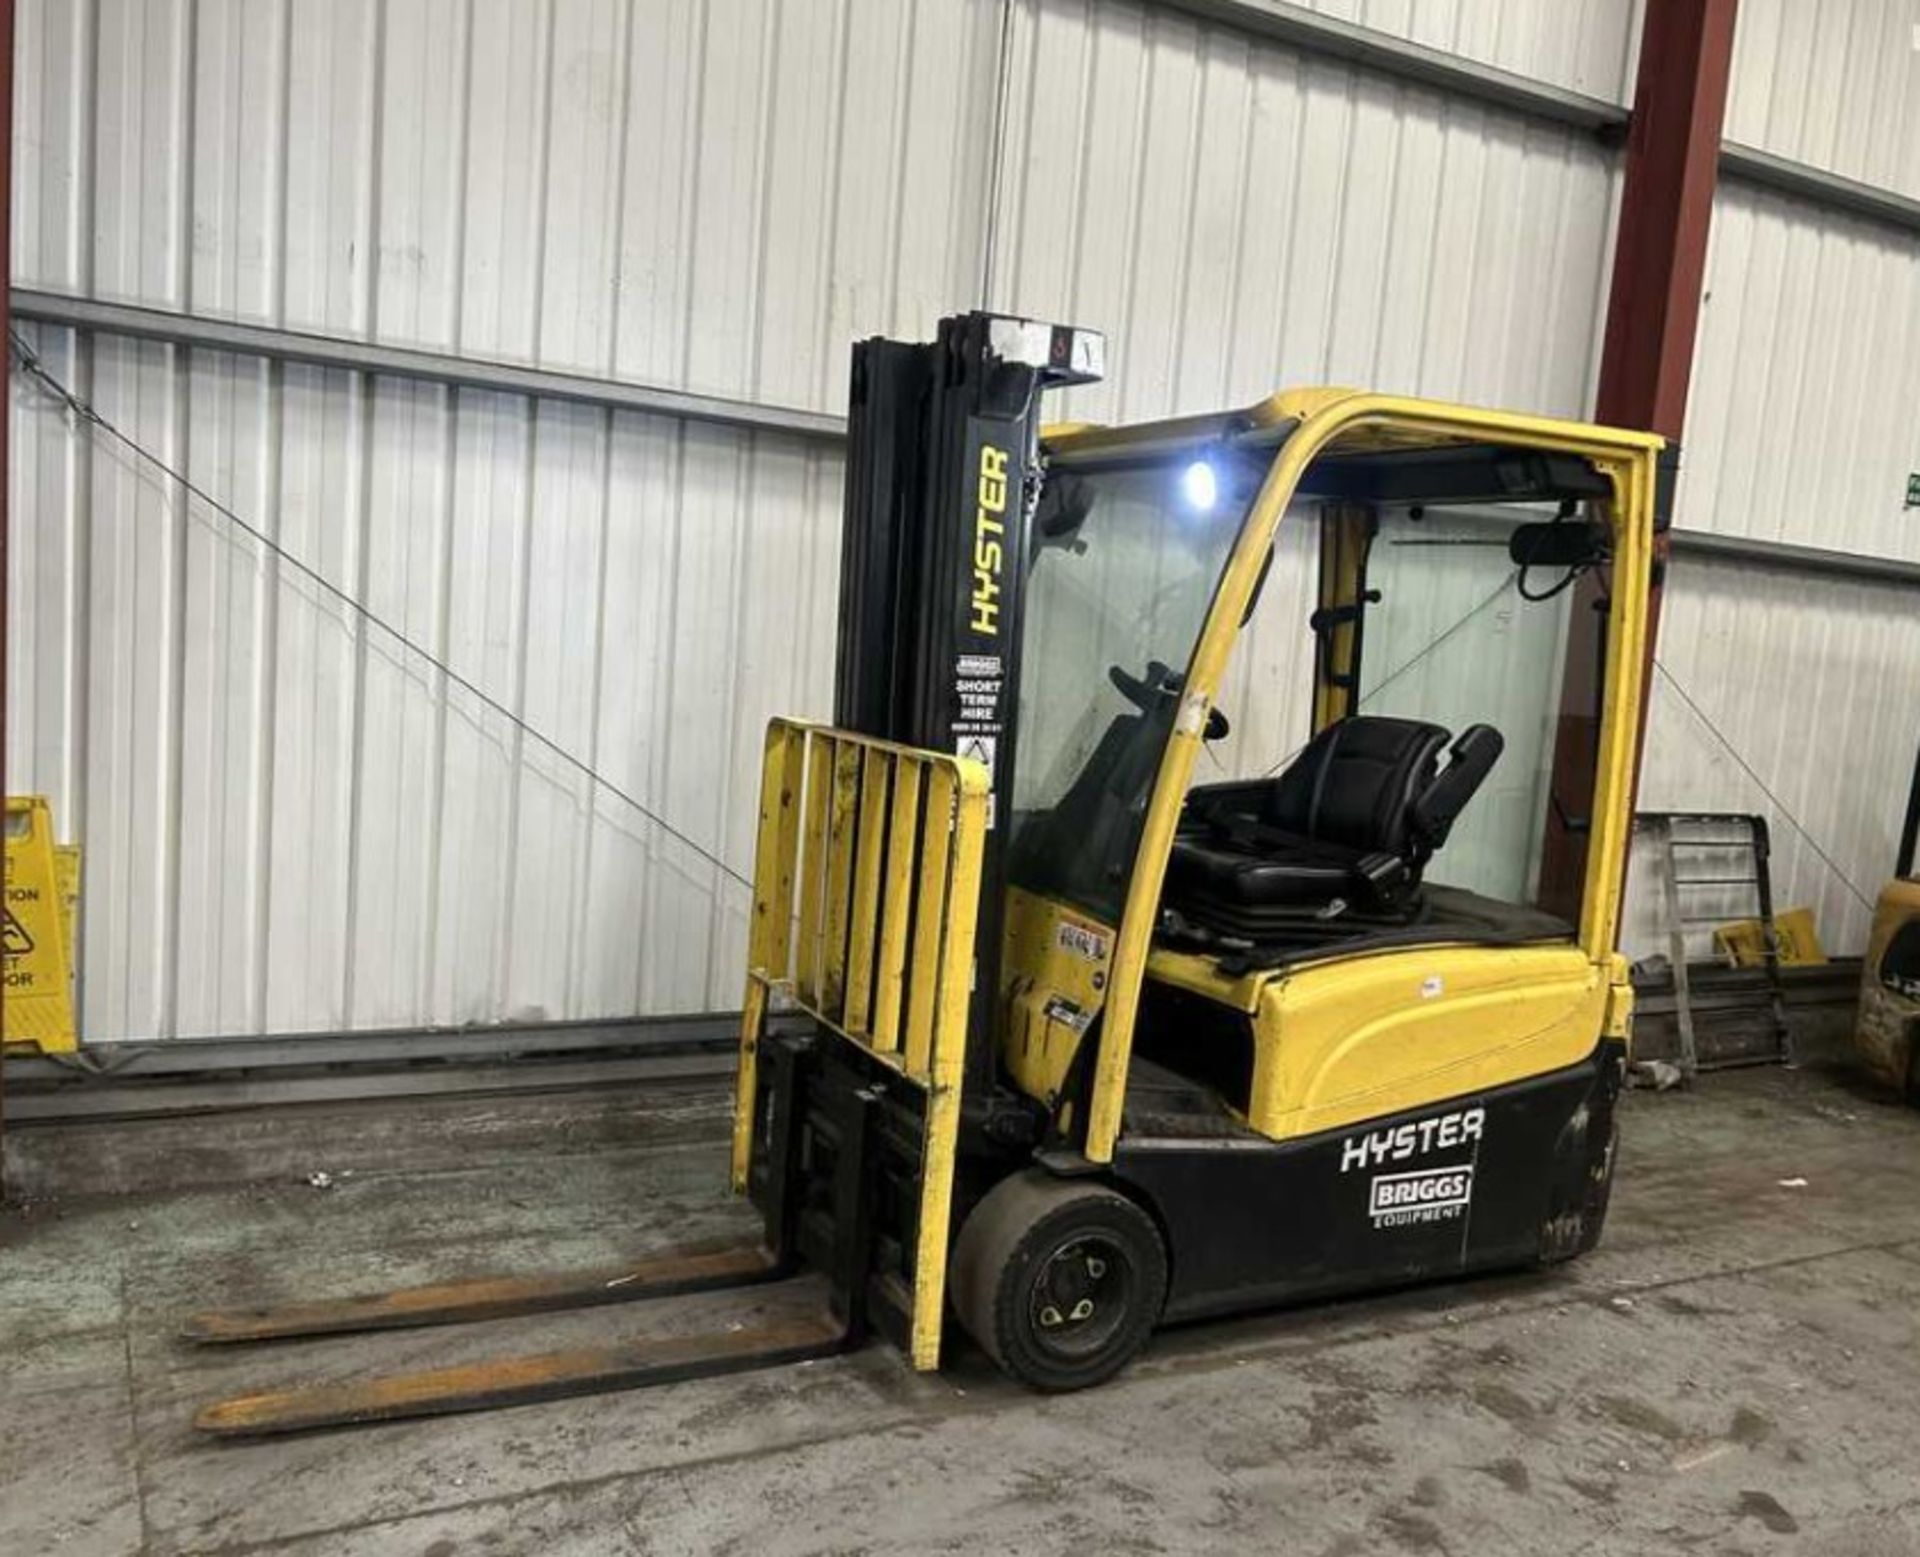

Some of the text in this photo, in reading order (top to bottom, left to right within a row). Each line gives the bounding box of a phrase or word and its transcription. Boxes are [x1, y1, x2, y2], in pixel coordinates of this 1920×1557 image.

[970, 444, 1009, 635] HYSTER
[955, 680, 1002, 693] SHORT
[959, 693, 998, 706] TERM
[960, 707, 994, 720] HIRE
[1340, 1107, 1485, 1172] HYSTER
[1377, 1175, 1464, 1207] BRIGGS
[1373, 1205, 1463, 1229] EQUIPMENT
